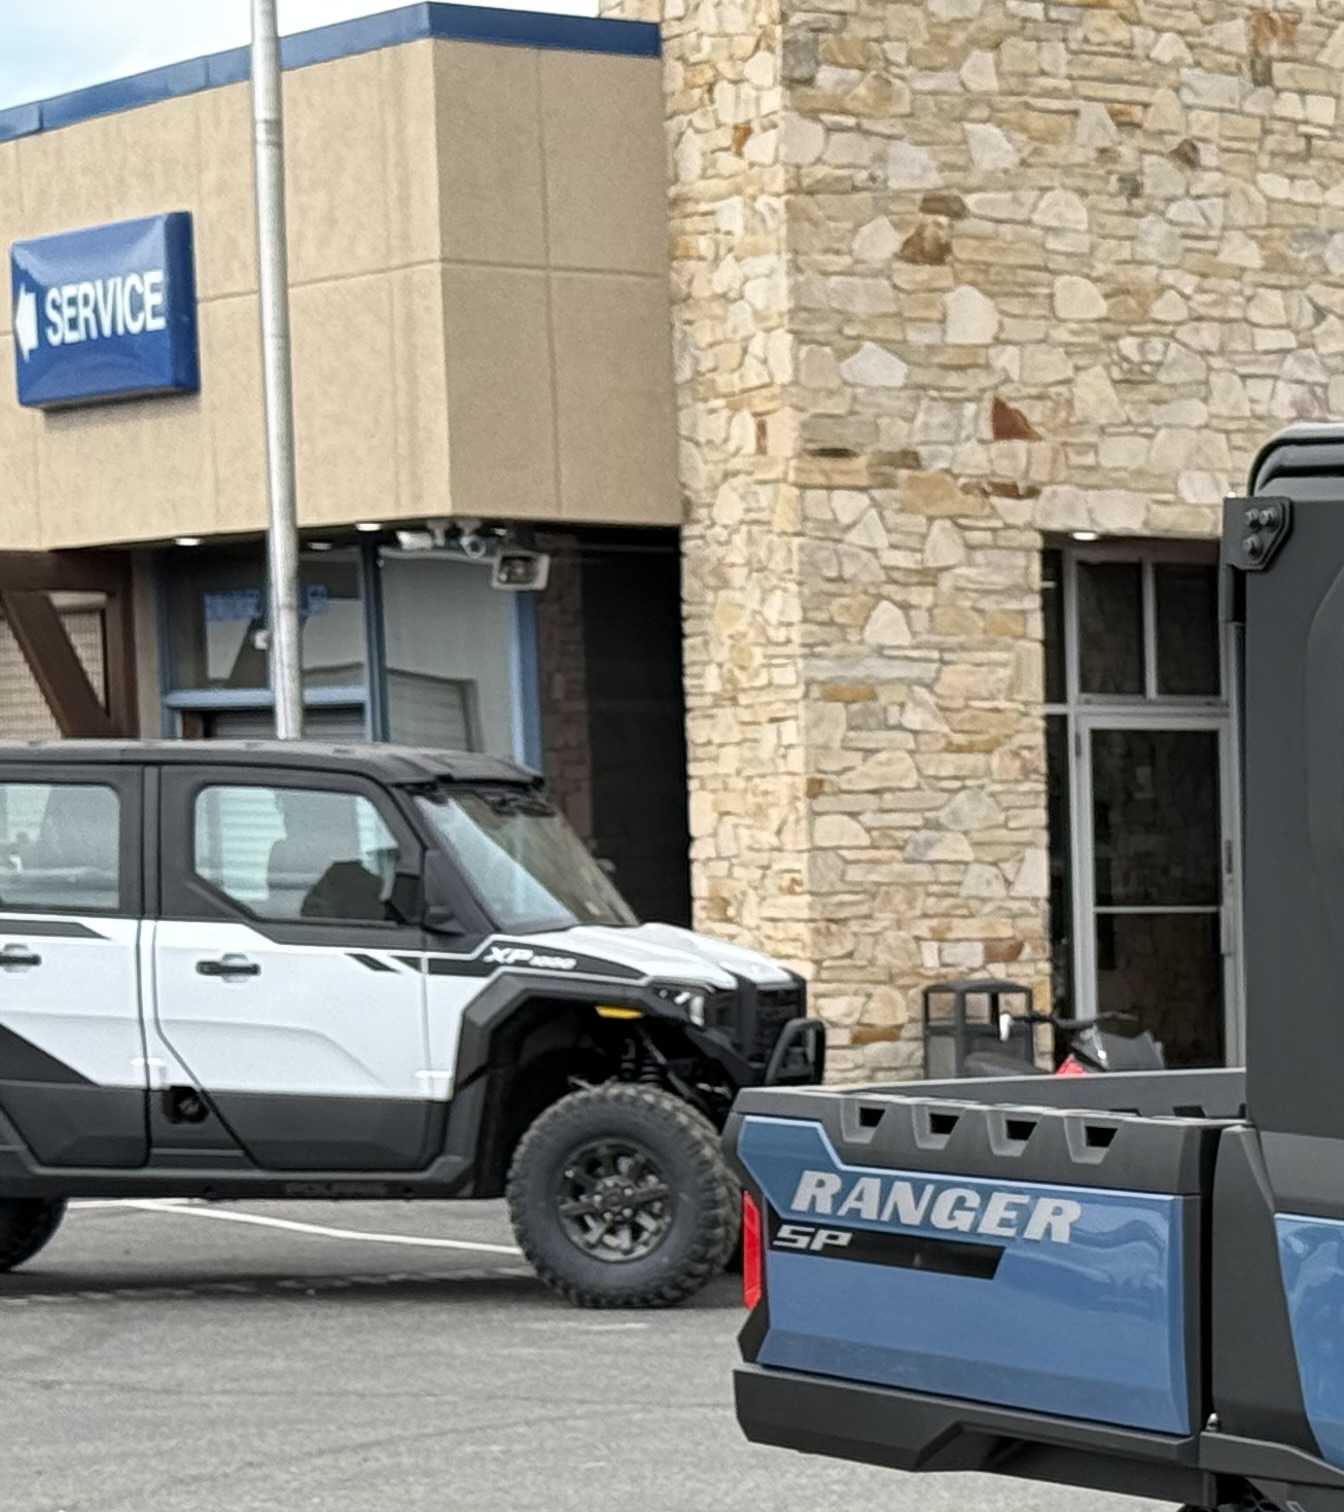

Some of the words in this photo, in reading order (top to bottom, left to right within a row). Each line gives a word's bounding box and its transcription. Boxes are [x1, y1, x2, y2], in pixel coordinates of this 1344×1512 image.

[45, 269, 166, 346] SERVICE
[483, 946, 534, 964] XP
[791, 1170, 1081, 1243] RANGER
[773, 1224, 853, 1251] SP
